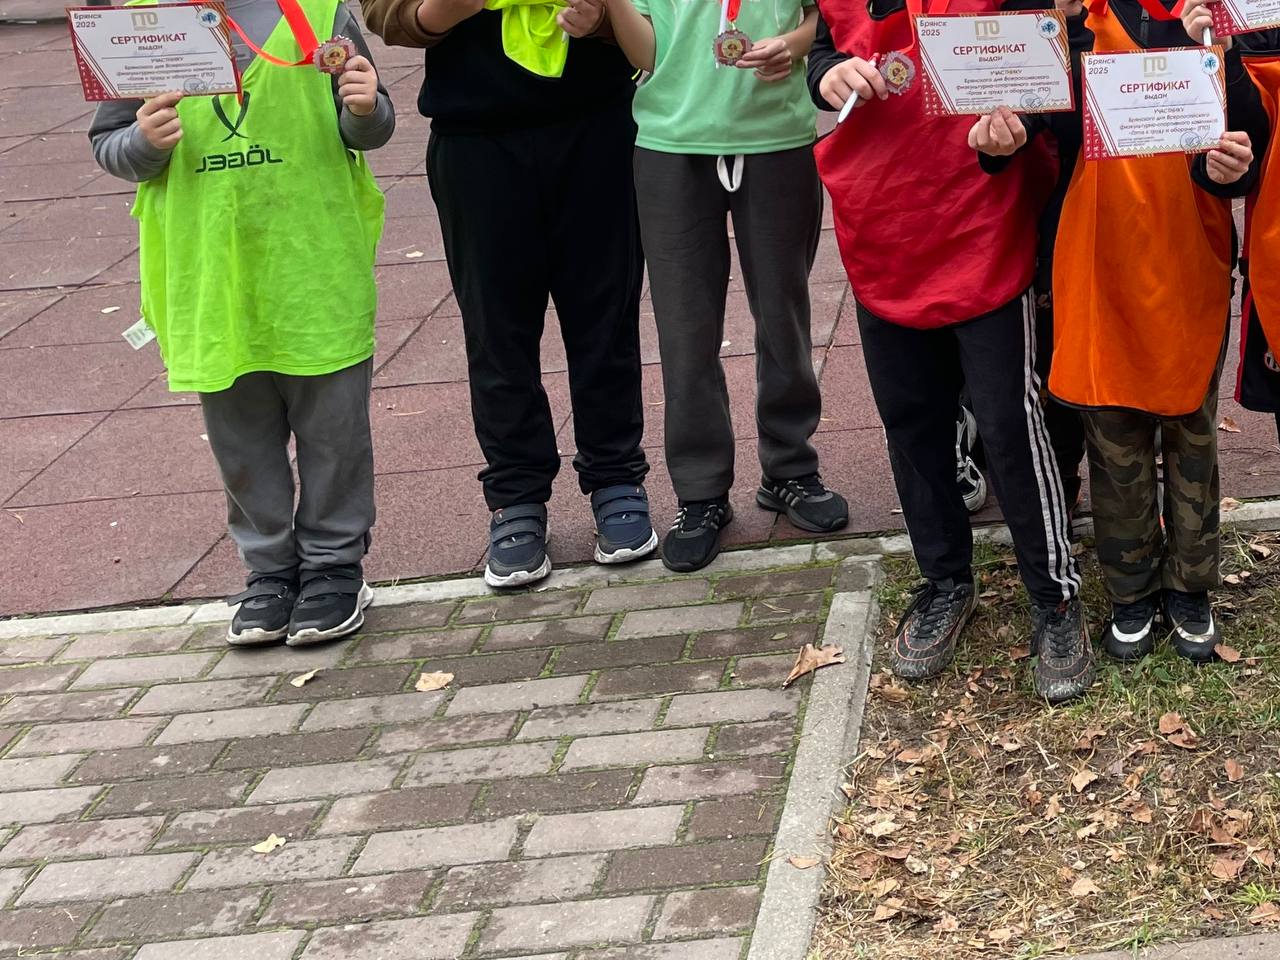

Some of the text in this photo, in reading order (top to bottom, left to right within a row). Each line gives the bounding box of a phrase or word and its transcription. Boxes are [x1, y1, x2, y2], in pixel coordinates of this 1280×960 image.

[919, 29, 940, 37] 2025
[109, 32, 187, 45] СЕРТИФИКАТ
[951, 43, 1026, 55] СЕРТИФИКАТ
[1088, 57, 1116, 65] Брянск
[1089, 66, 1108, 74] 2025
[1119, 80, 1190, 93] СЕРТИФИКАТ
